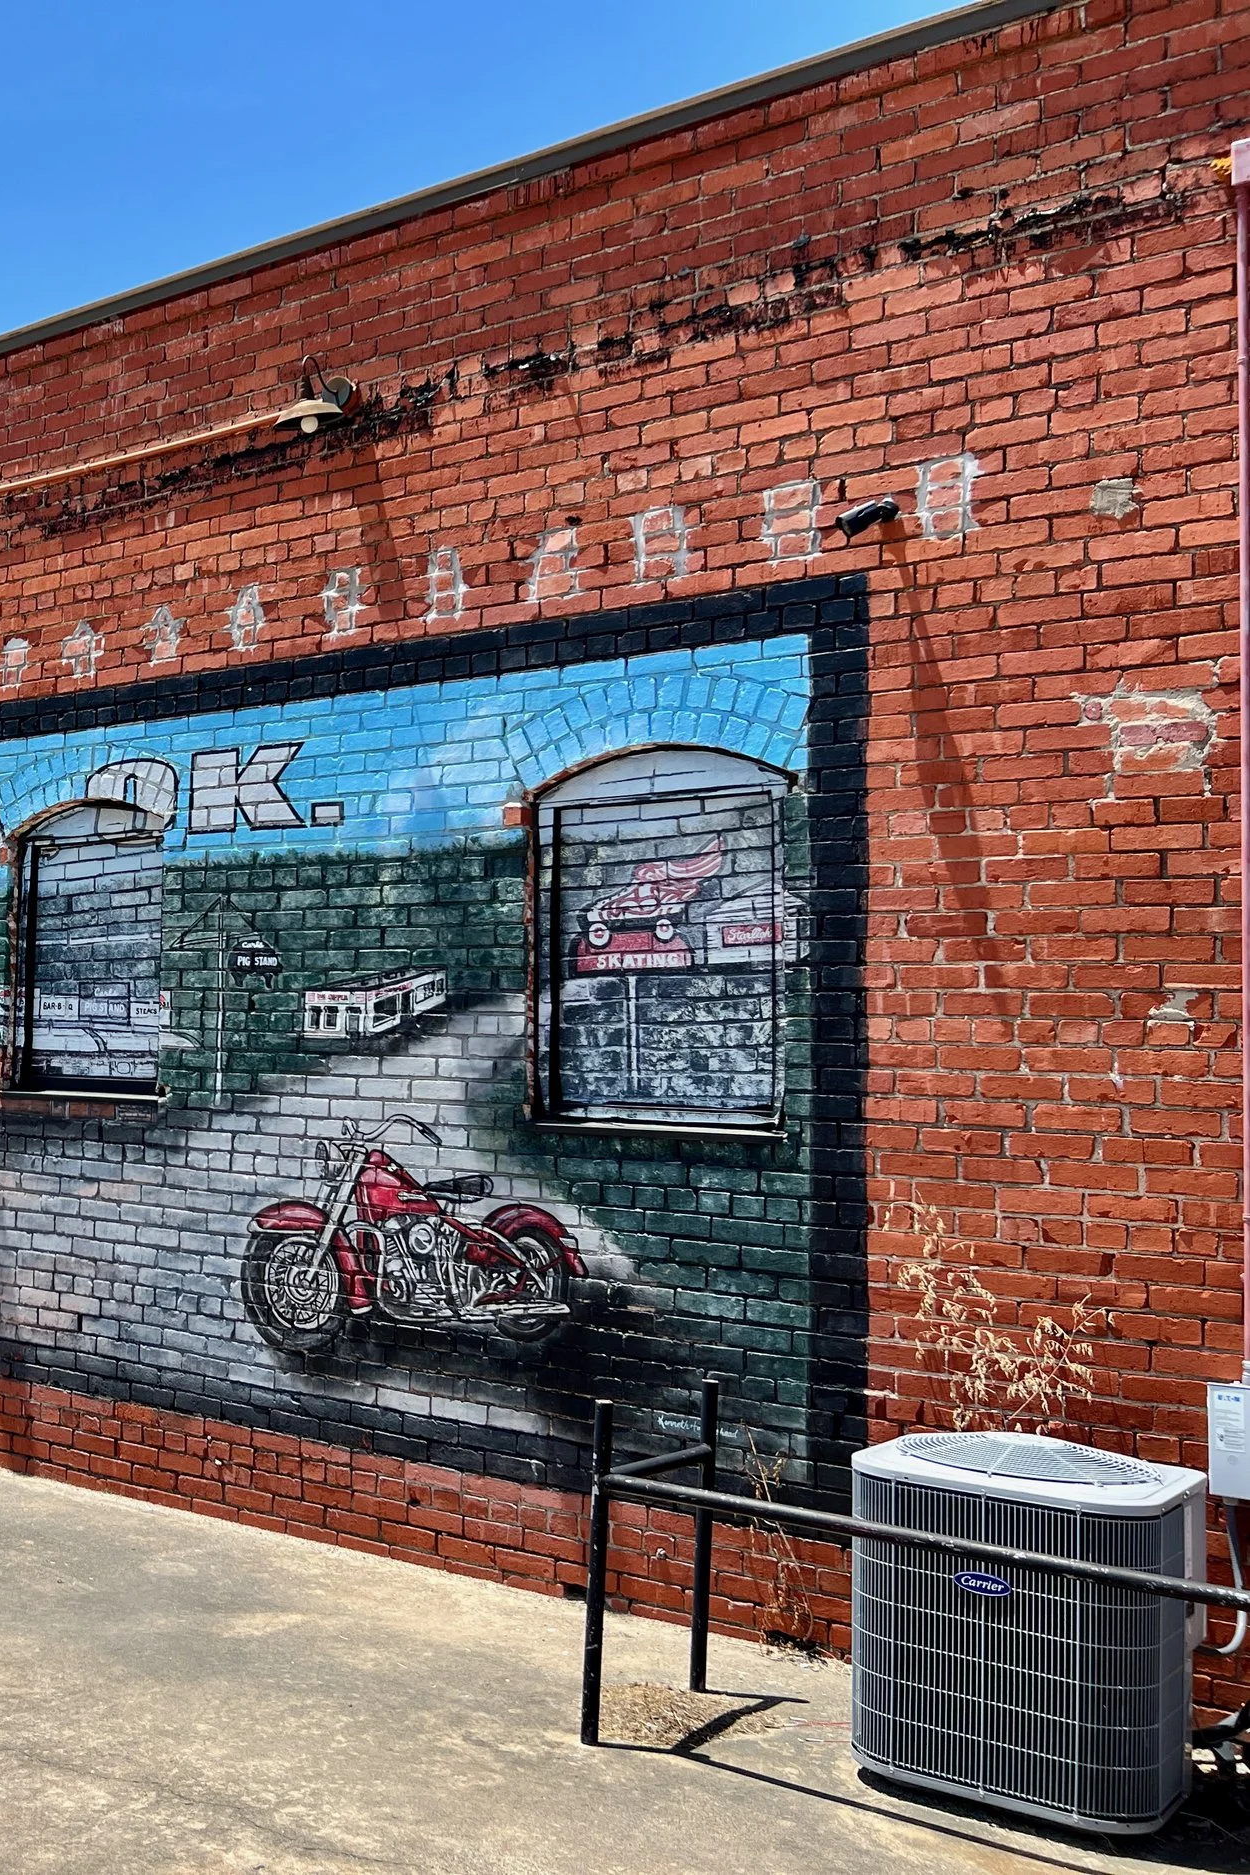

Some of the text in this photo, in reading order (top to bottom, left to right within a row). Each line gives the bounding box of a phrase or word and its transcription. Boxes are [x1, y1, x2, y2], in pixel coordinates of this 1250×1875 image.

[237, 955, 278, 967] PIG STAND
[596, 953, 681, 970] SKATING
[99, 1003, 125, 1013] STAND
[961, 1576, 1005, 1592] Carrier
